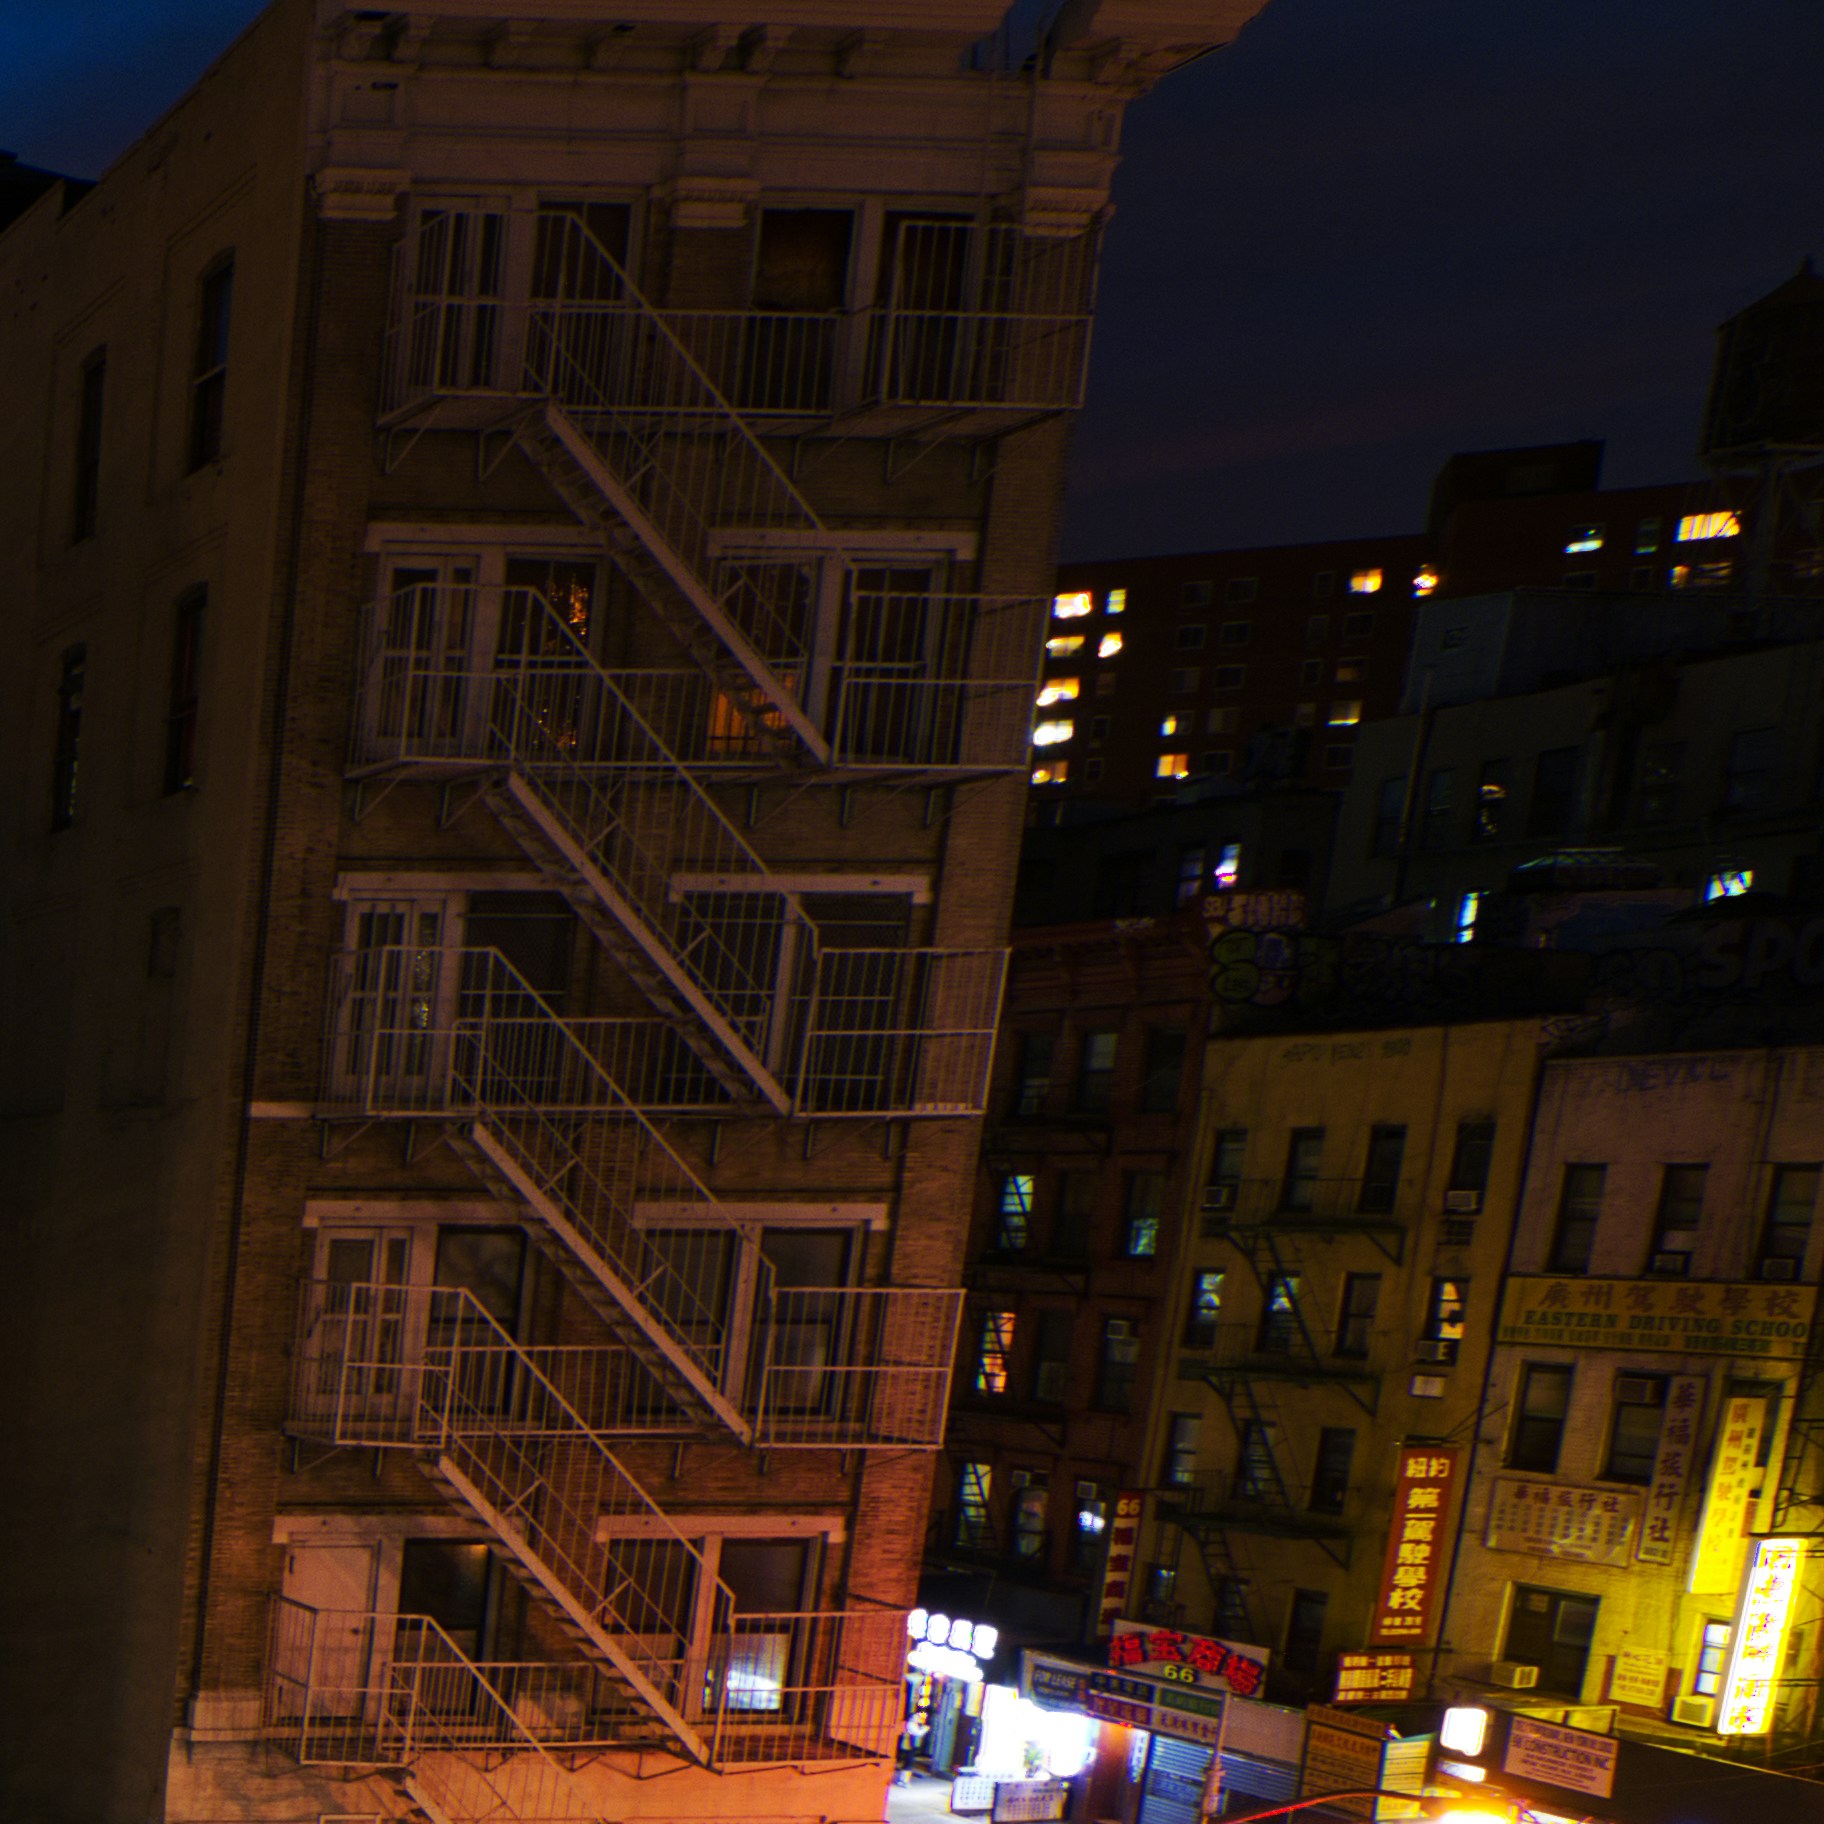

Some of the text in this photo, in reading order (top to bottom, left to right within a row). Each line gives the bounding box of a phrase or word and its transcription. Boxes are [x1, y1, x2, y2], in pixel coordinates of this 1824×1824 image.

[1525, 1310, 1620, 1328] EASTERN
[1628, 1314, 1722, 1334] DRIVING
[1405, 1457, 1451, 1478] 紐約
[1116, 1499, 1141, 1516] 66
[1387, 1487, 1441, 1611] 第一駕駛學校
[1051, 1672, 1078, 1690] LEASE
[1163, 1664, 1196, 1684] 66
